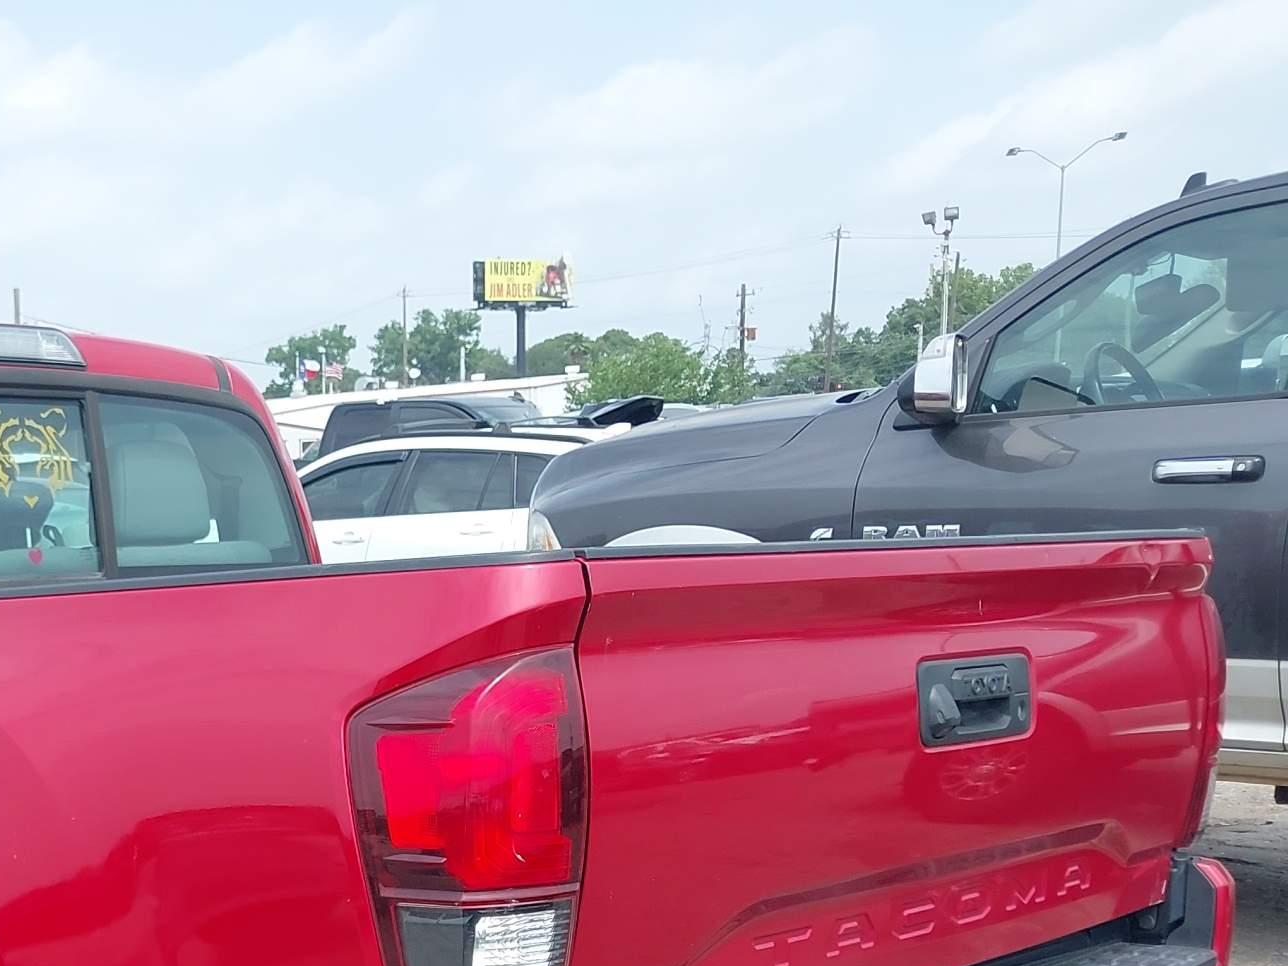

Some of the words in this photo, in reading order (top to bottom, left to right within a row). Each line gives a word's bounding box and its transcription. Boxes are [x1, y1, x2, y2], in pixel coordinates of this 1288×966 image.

[489, 261, 532, 276] INJURED?
[489, 282, 504, 298] JIM
[505, 282, 533, 298] ADLER
[863, 524, 960, 539] RAM
